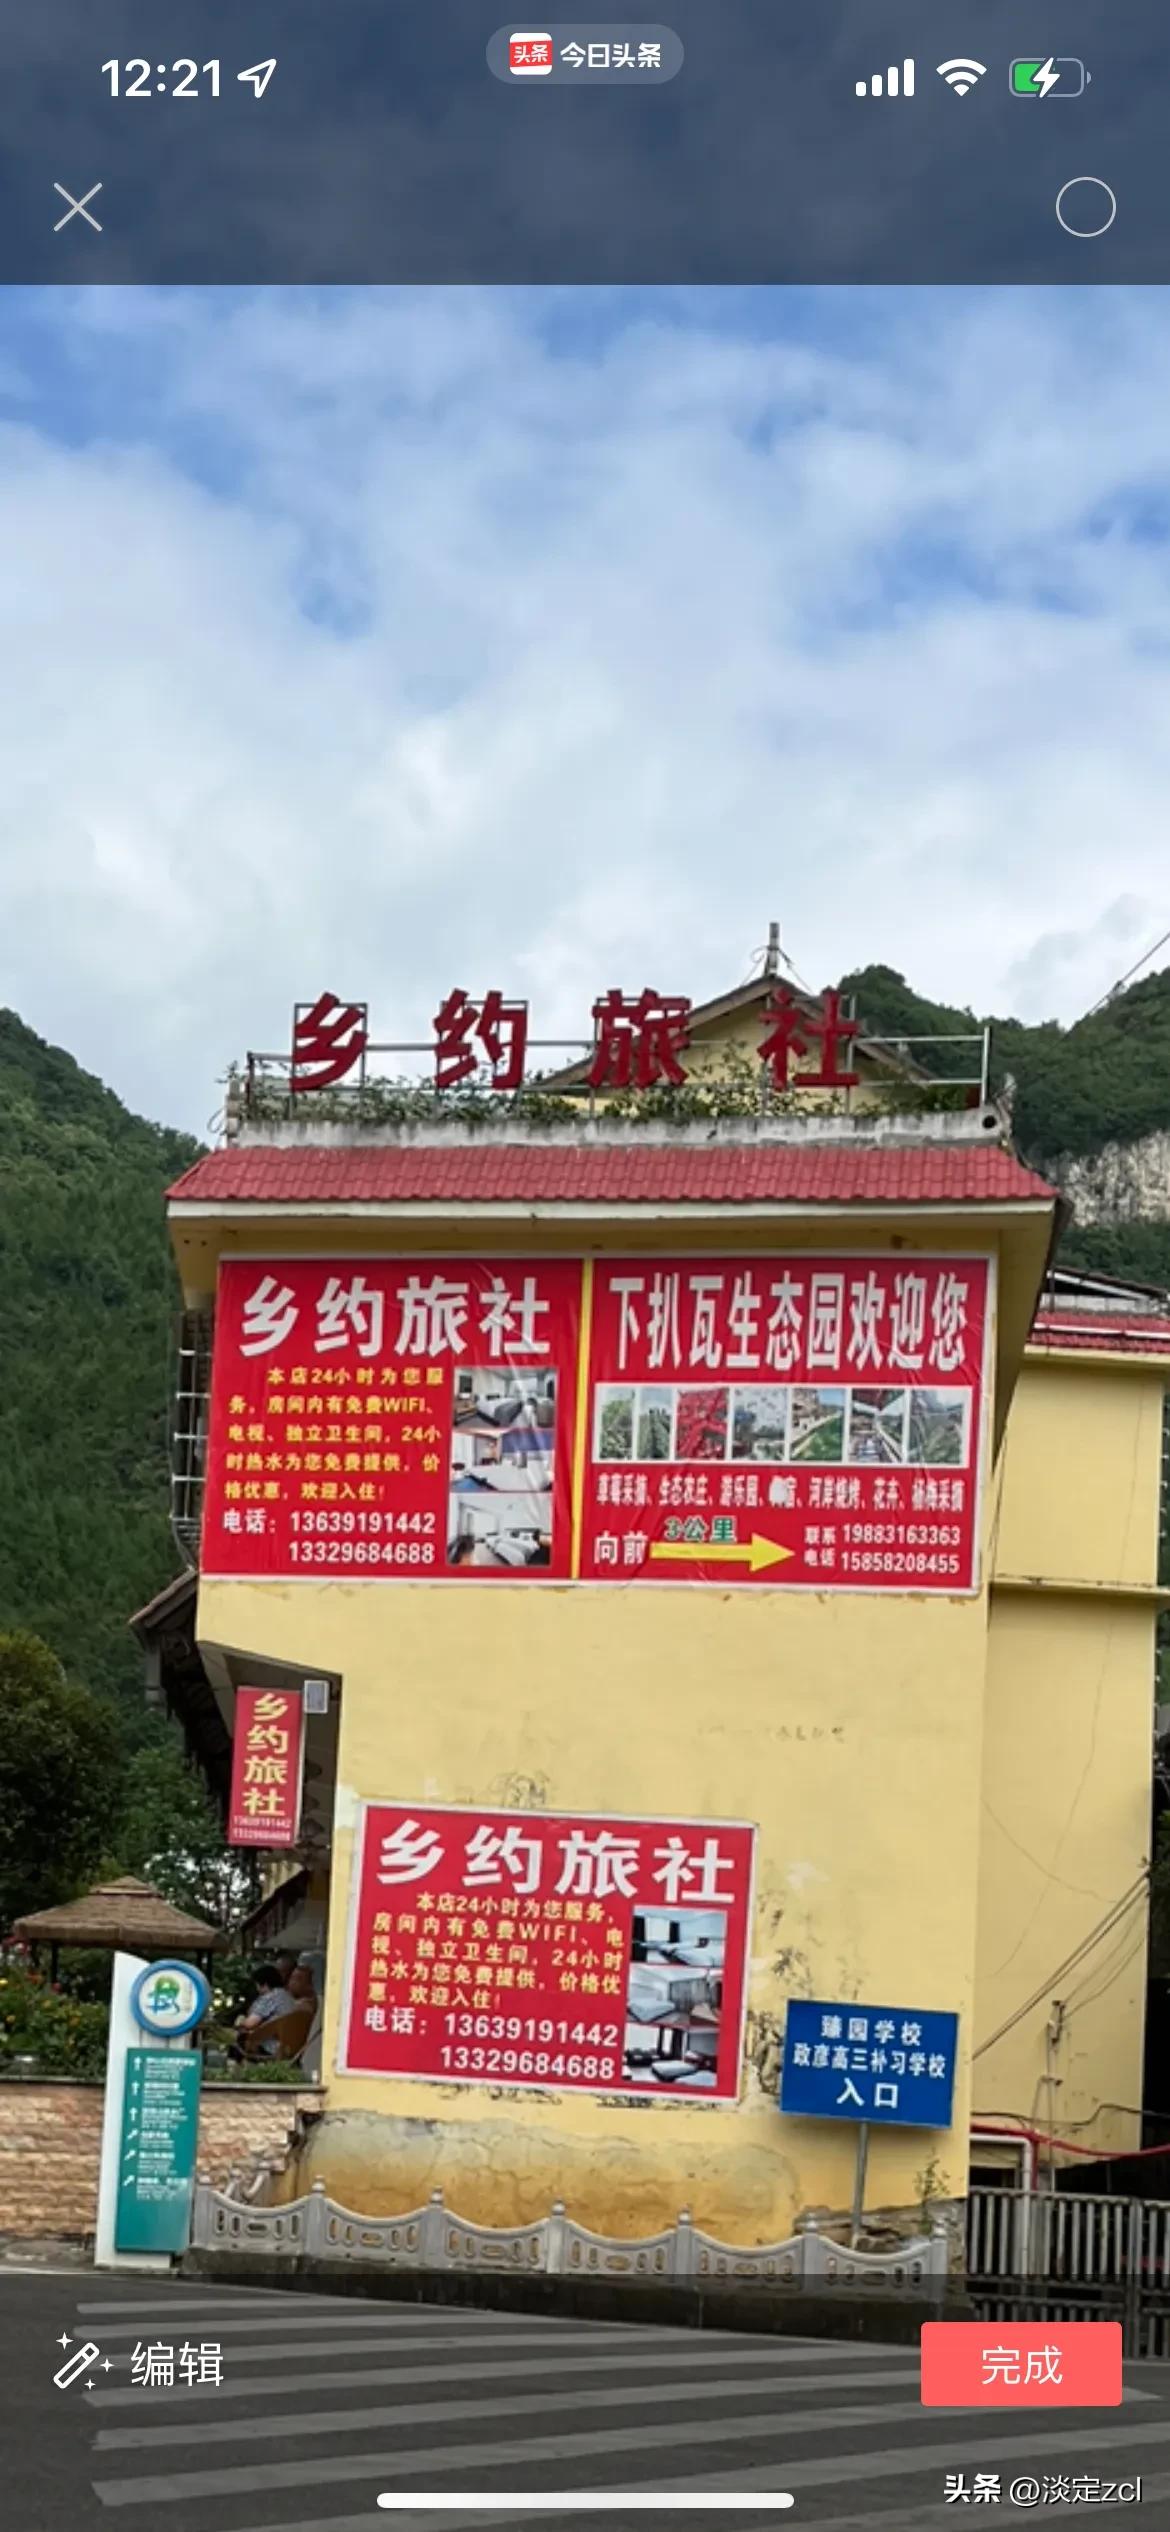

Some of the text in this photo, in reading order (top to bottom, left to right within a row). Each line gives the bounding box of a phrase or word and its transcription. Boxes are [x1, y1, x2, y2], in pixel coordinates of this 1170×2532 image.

[290, 988, 860, 1092] 乡约旅社
[239, 1274, 550, 1357] 乡约旅社
[609, 1270, 969, 1372] 下扒瓦生态园欢迎您
[267, 1367, 444, 1386] 本店24小时为您服
[593, 1529, 648, 1566] 向前
[664, 1514, 738, 1545] 3公里
[842, 1523, 961, 1546] 19883163363
[288, 1541, 435, 1564] 13329684688
[803, 1548, 960, 1574] 电话 15858208455
[242, 1692, 289, 1817] 乡约旅社
[376, 1818, 735, 1904] 乡约旅社
[440, 2045, 615, 2081] 13329684688
[836, 2076, 899, 2110] 入口
